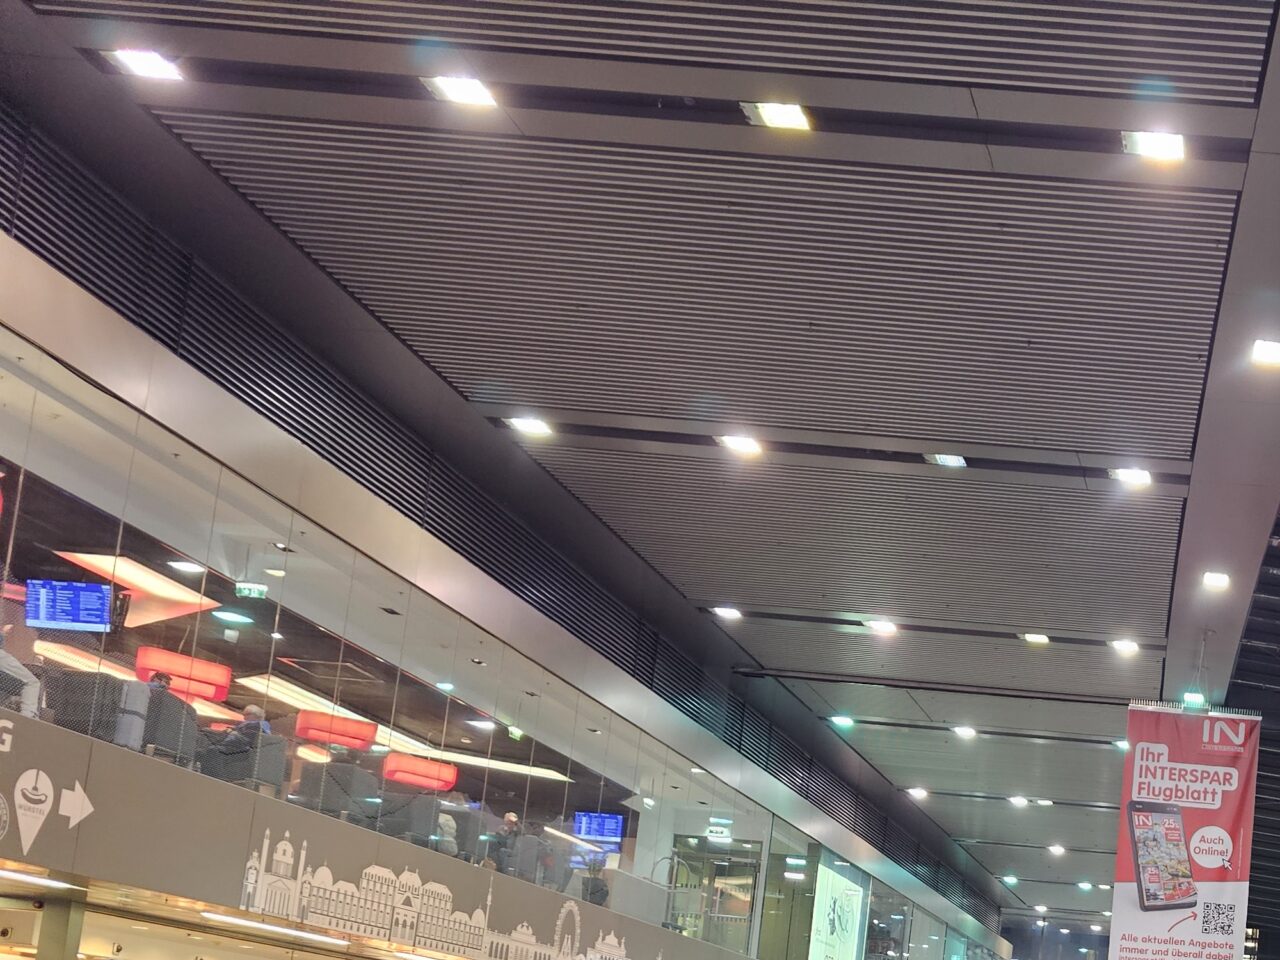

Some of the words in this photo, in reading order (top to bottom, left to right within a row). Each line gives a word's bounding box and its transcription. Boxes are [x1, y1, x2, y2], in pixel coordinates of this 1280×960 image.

[1202, 719, 1246, 745] IN
[1140, 747, 1164, 763] Ihr
[1138, 764, 1233, 787] INTERSPAR
[1137, 781, 1218, 802] Flugblatt
[1199, 835, 1224, 846] Auch
[1193, 846, 1229, 857] Online!
[1120, 933, 1139, 943] Alle
[1141, 936, 1185, 947] aktuellen
[1188, 939, 1234, 951] Angebote
[1119, 944, 1149, 954] immer
[1151, 947, 1169, 957] und
[1171, 949, 1203, 960] überall
